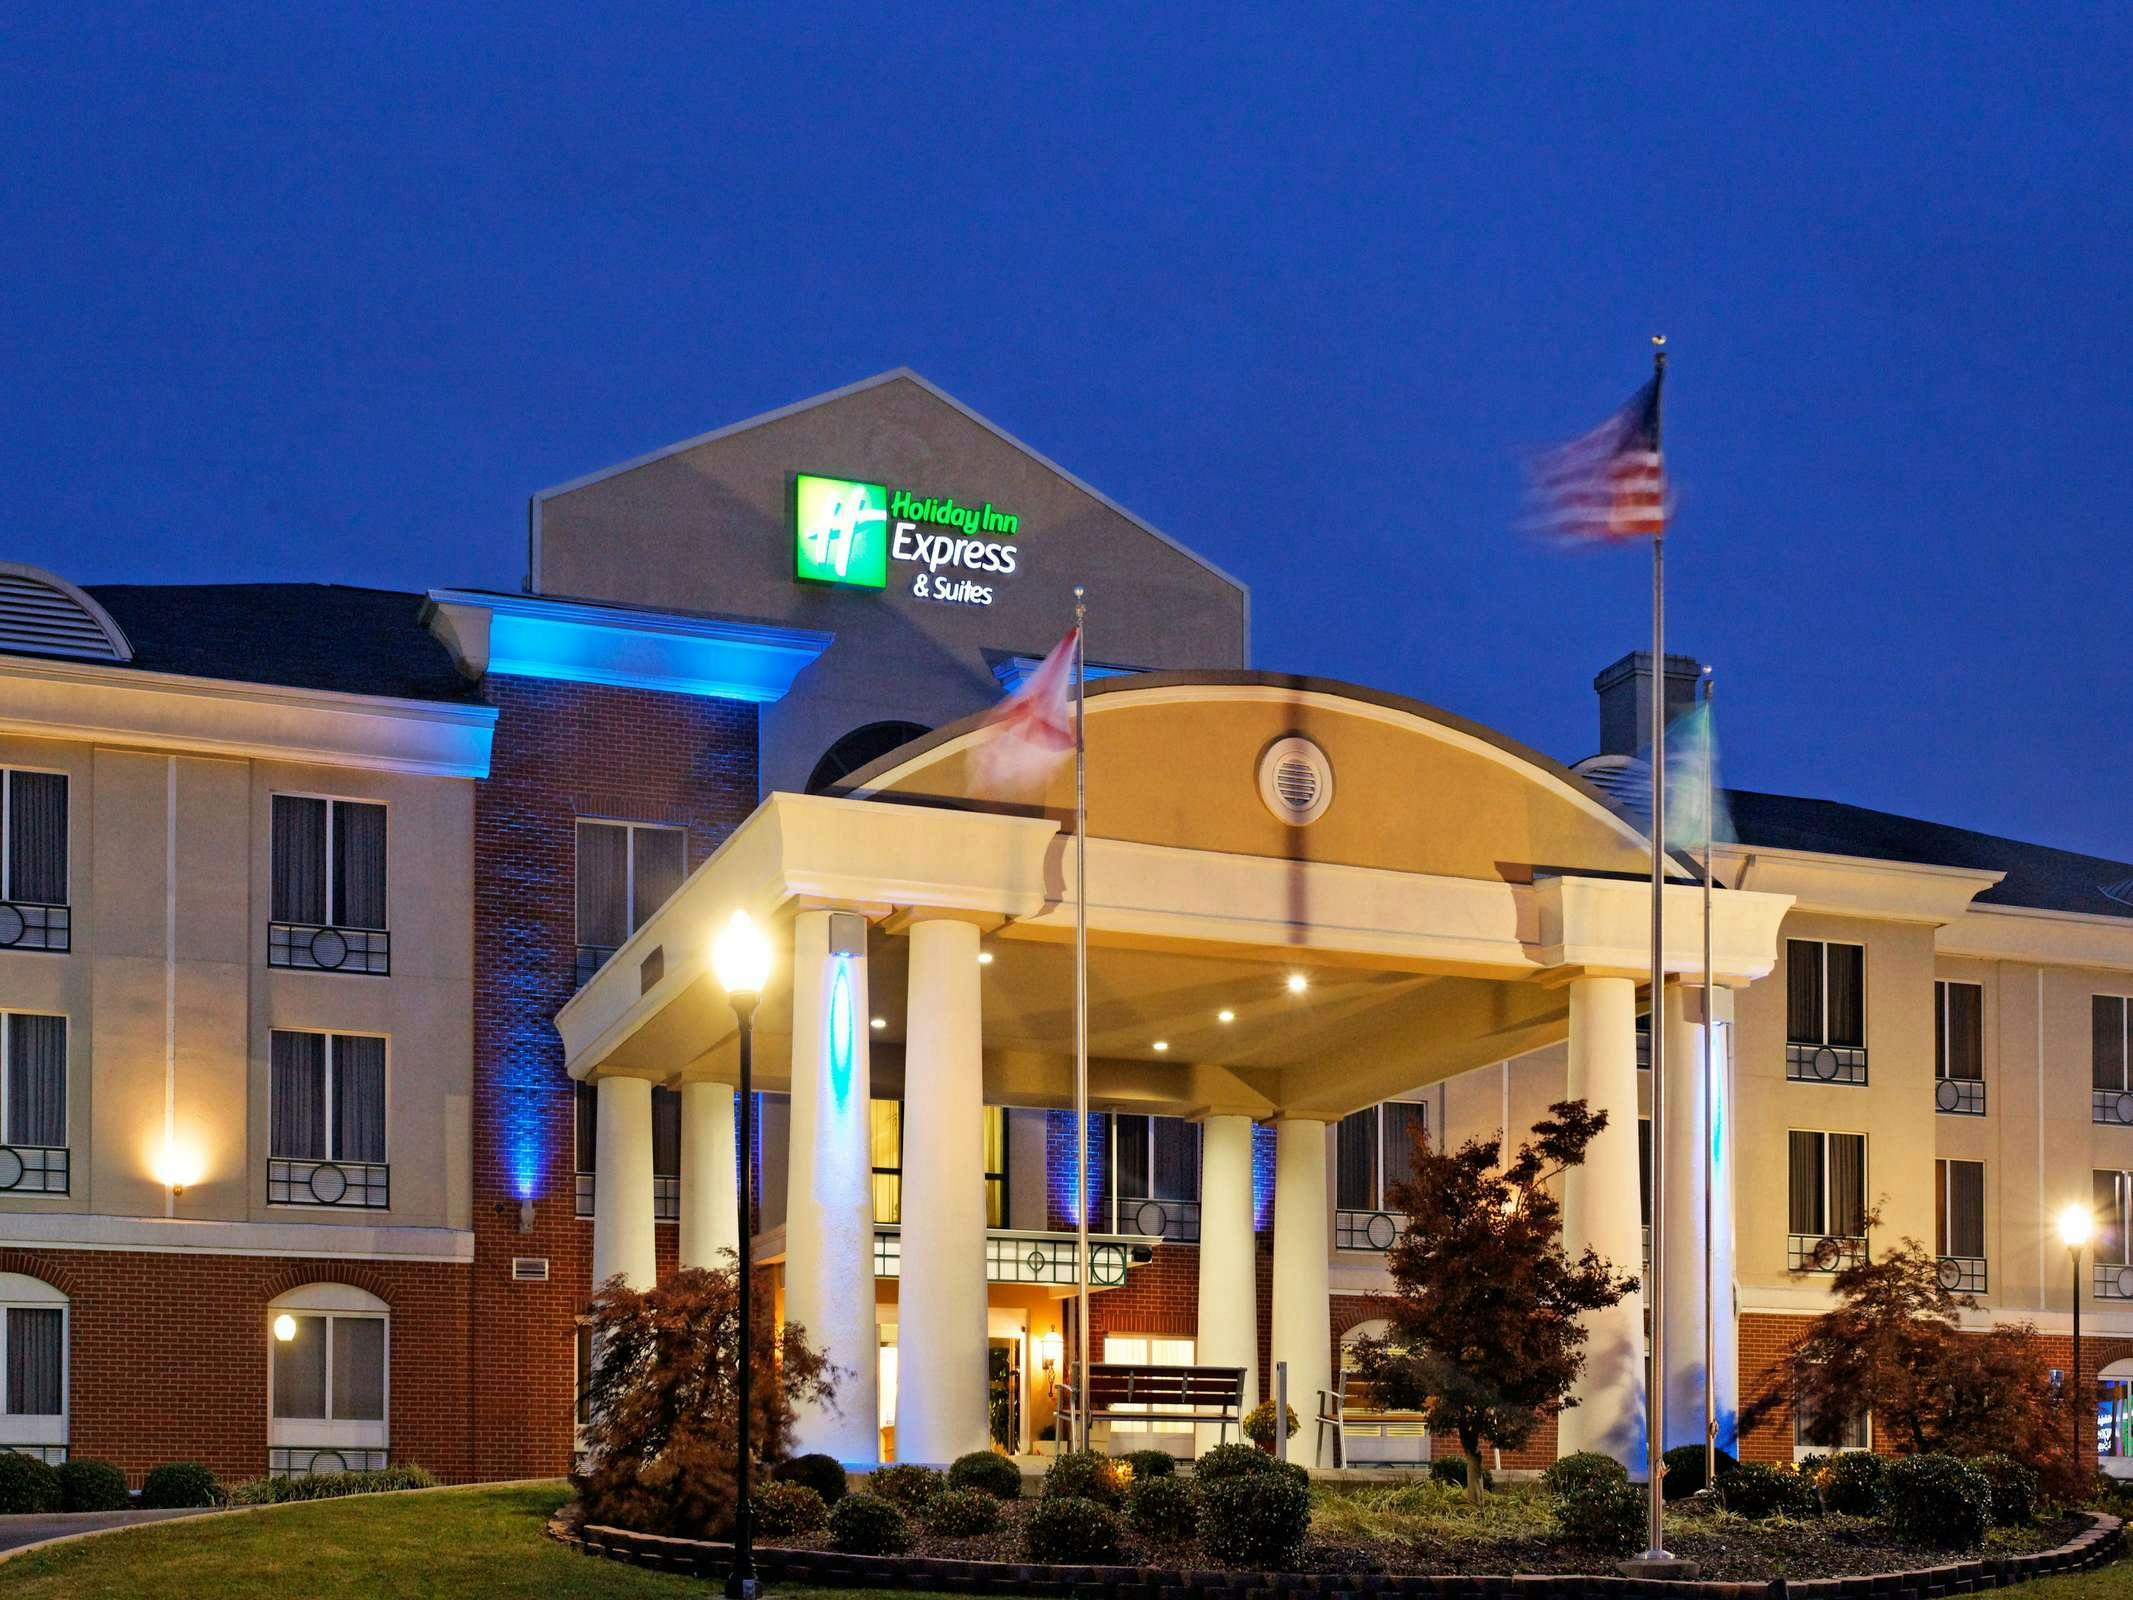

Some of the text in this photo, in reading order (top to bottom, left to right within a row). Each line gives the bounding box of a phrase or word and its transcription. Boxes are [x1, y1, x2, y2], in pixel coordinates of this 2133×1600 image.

[891, 490, 1018, 535] Holiday Inn
[892, 522, 1017, 573] Express
[913, 573, 993, 605] & Suites
